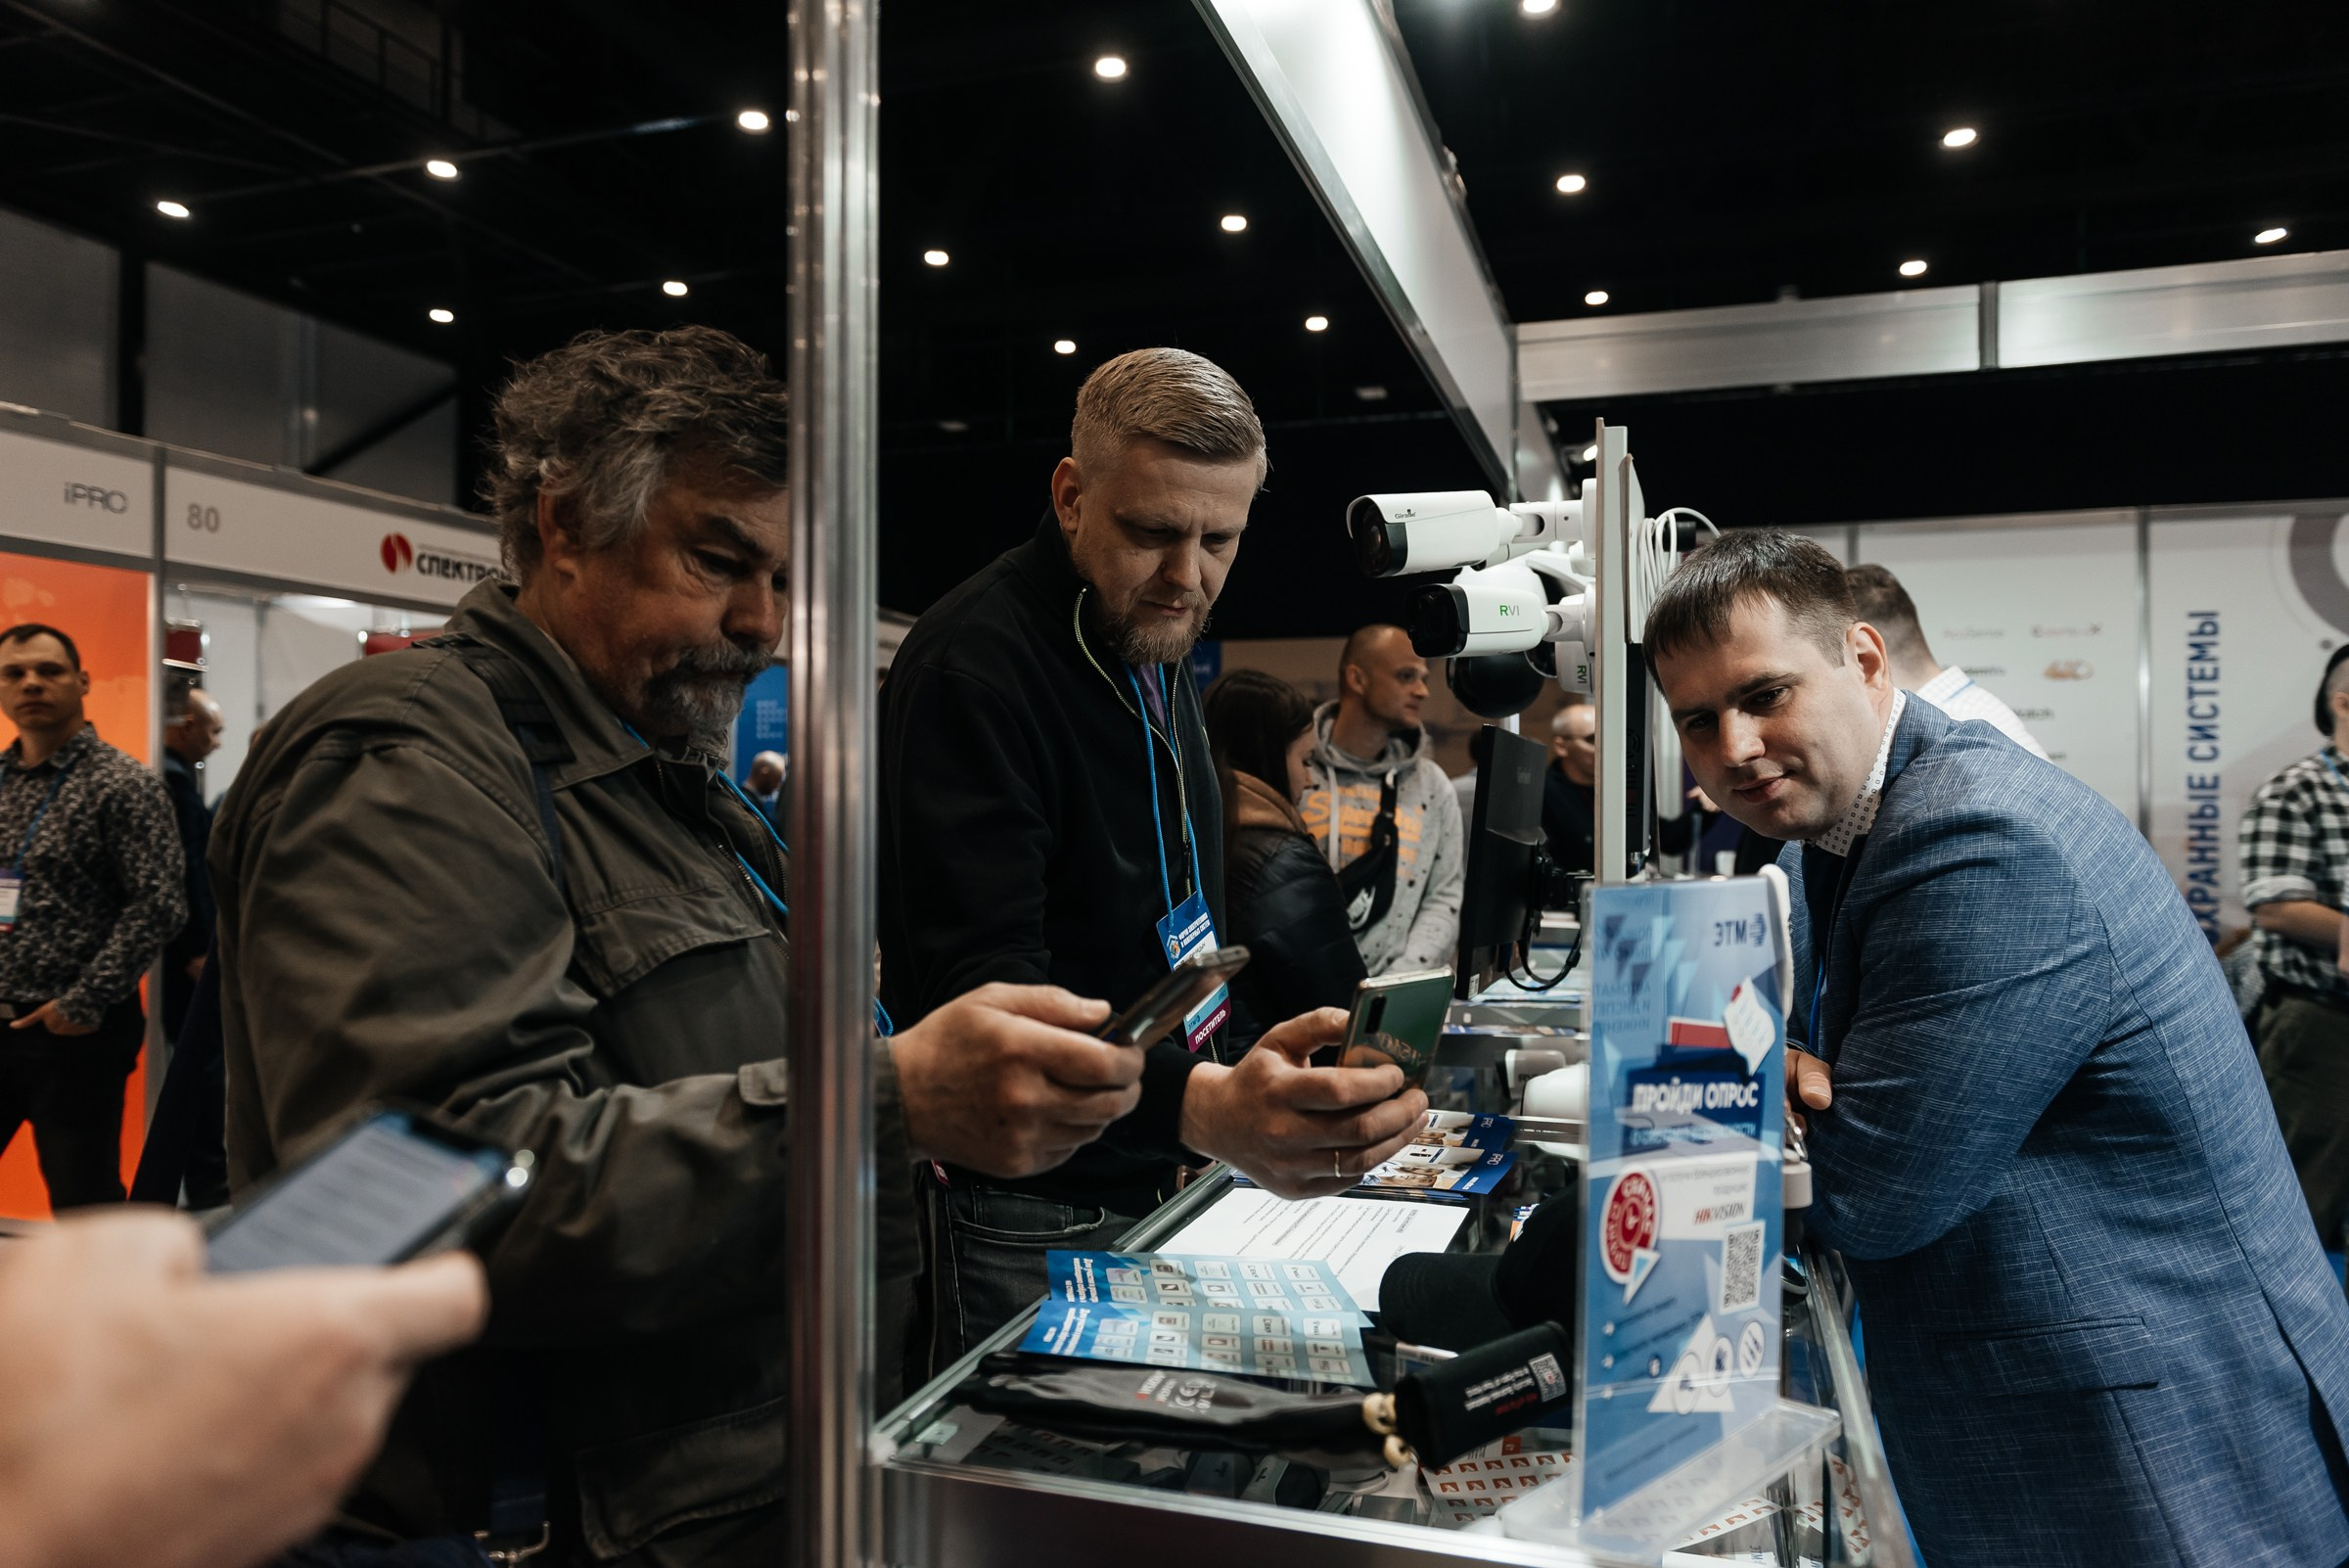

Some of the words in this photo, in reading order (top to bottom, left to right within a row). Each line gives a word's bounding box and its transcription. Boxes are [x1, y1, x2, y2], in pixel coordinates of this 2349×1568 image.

[187, 503, 220, 533] 80
[1499, 605, 1520, 617] RVI
[1577, 665, 1588, 684] RVI
[2187, 611, 2220, 762] СИСТЕМЫ
[1715, 920, 1747, 946] ЭТМ
[1195, 1009, 1226, 1044] ПОСЕТИТЕЛЬ
[1632, 1077, 1704, 1115] ПРОЙДИ
[1705, 1082, 1759, 1109] ОПРОС
